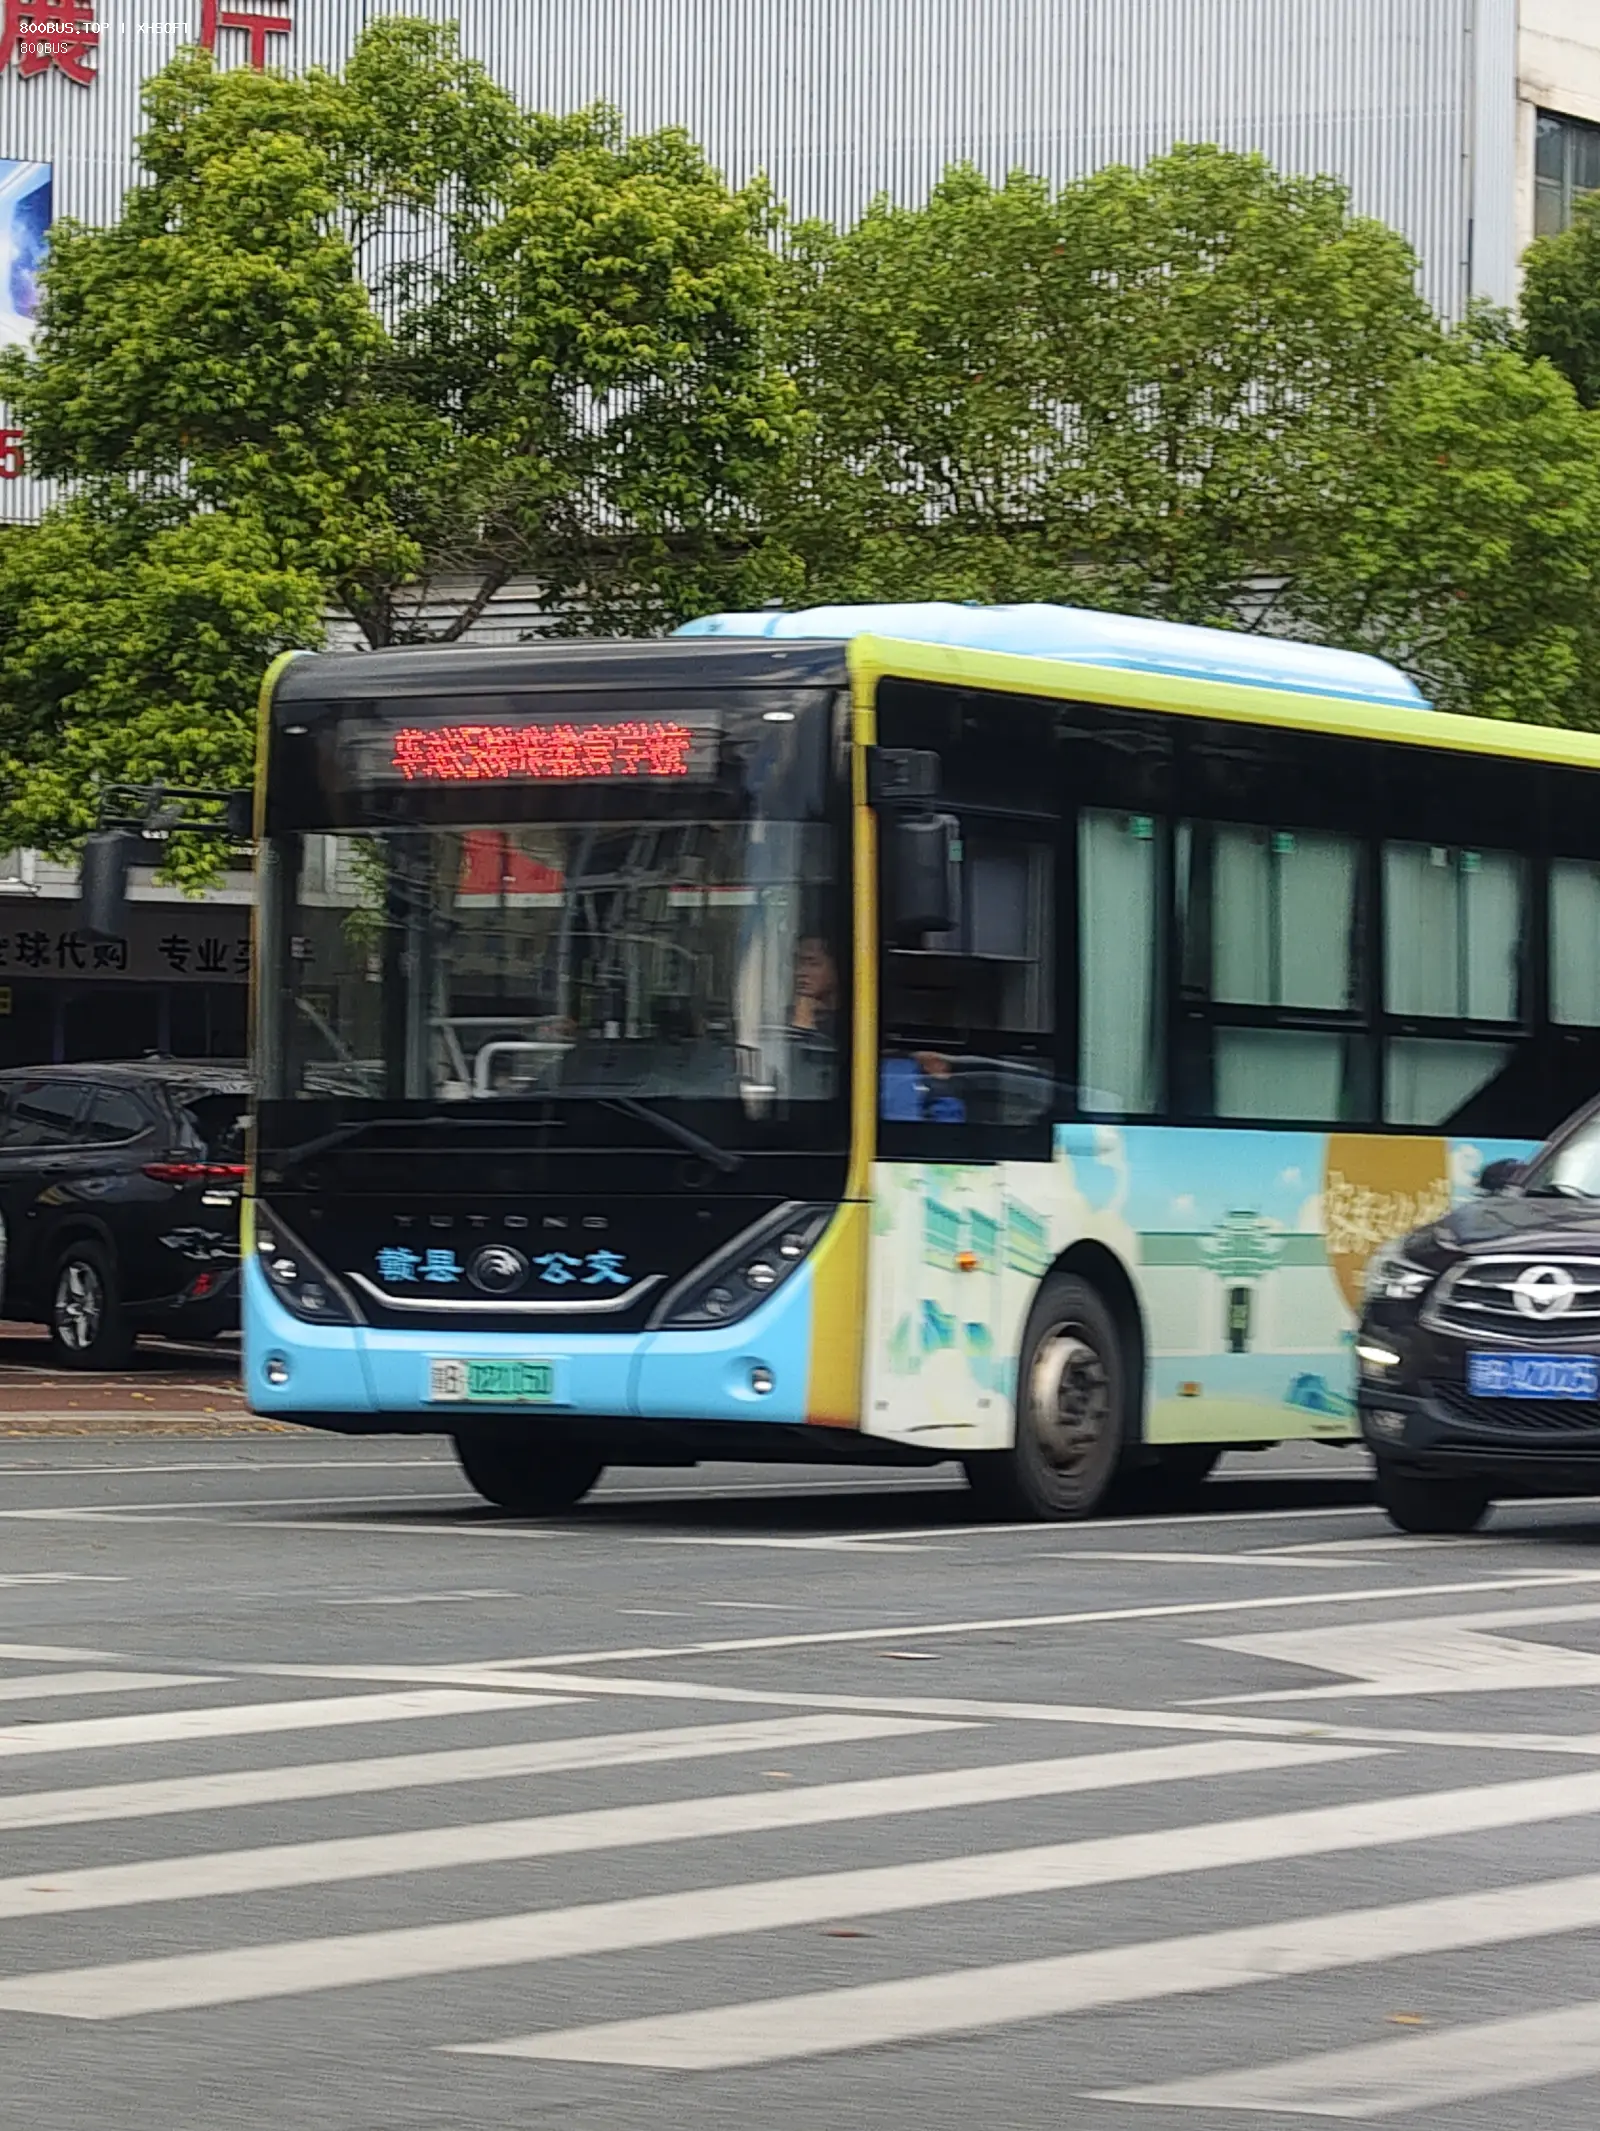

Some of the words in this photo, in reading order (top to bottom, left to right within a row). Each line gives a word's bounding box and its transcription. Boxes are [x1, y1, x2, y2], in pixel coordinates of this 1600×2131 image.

[0, 931, 128, 971] 球代购
[532, 1249, 632, 1285] 公交
